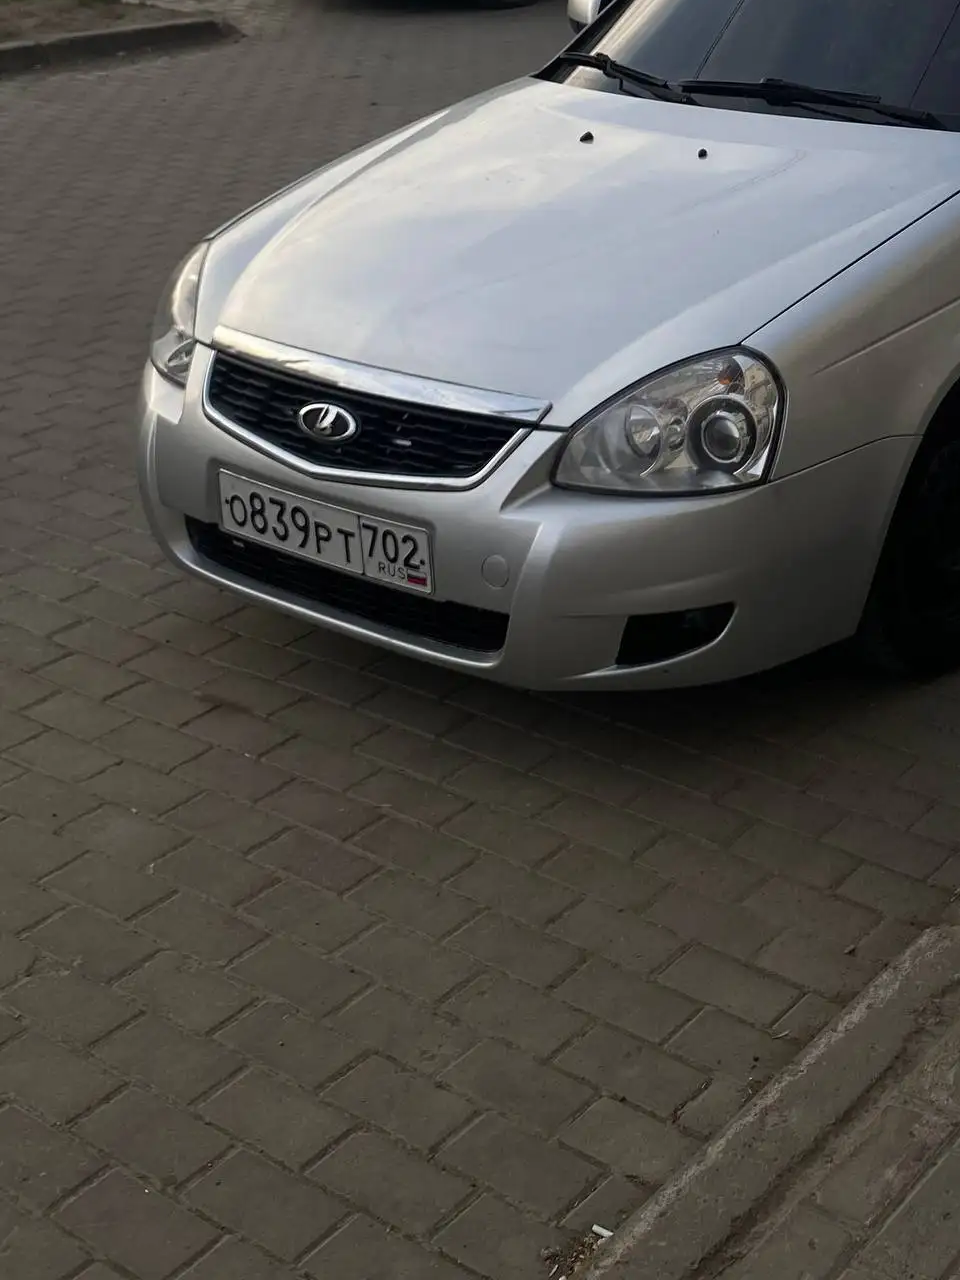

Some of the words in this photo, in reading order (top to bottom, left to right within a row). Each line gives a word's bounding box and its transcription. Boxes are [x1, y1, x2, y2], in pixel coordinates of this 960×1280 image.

[229, 491, 356, 564] О839РТ
[361, 522, 421, 570] 702
[378, 561, 406, 579] RUS
